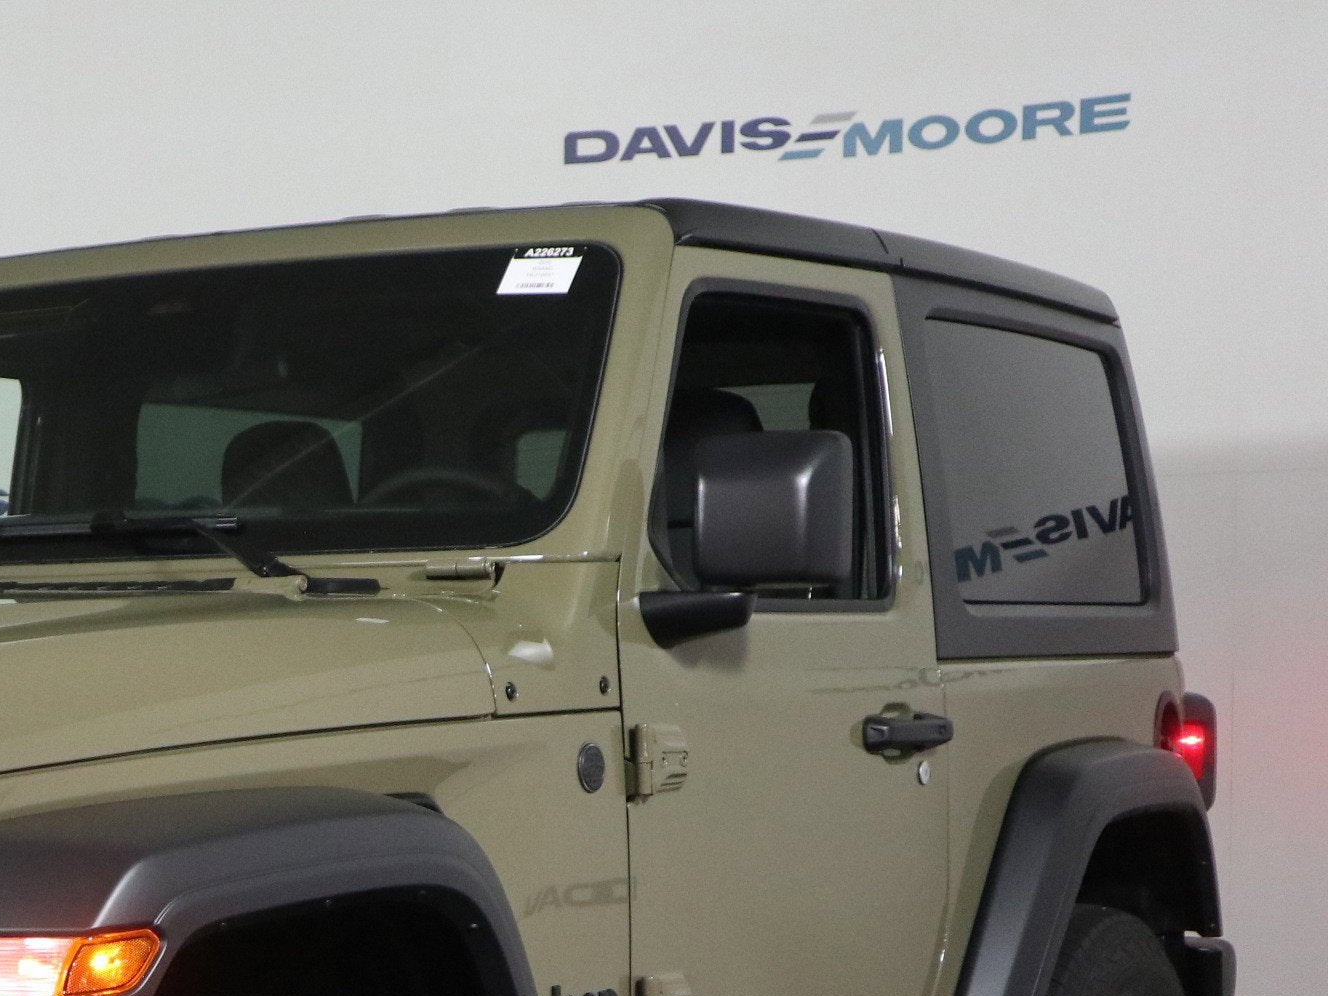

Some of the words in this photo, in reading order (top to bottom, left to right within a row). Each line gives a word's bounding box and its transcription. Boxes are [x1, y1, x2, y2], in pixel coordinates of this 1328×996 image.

[563, 115, 793, 165] DAVIS
[842, 92, 1132, 158] MOORE
[524, 246, 575, 257] A226273
